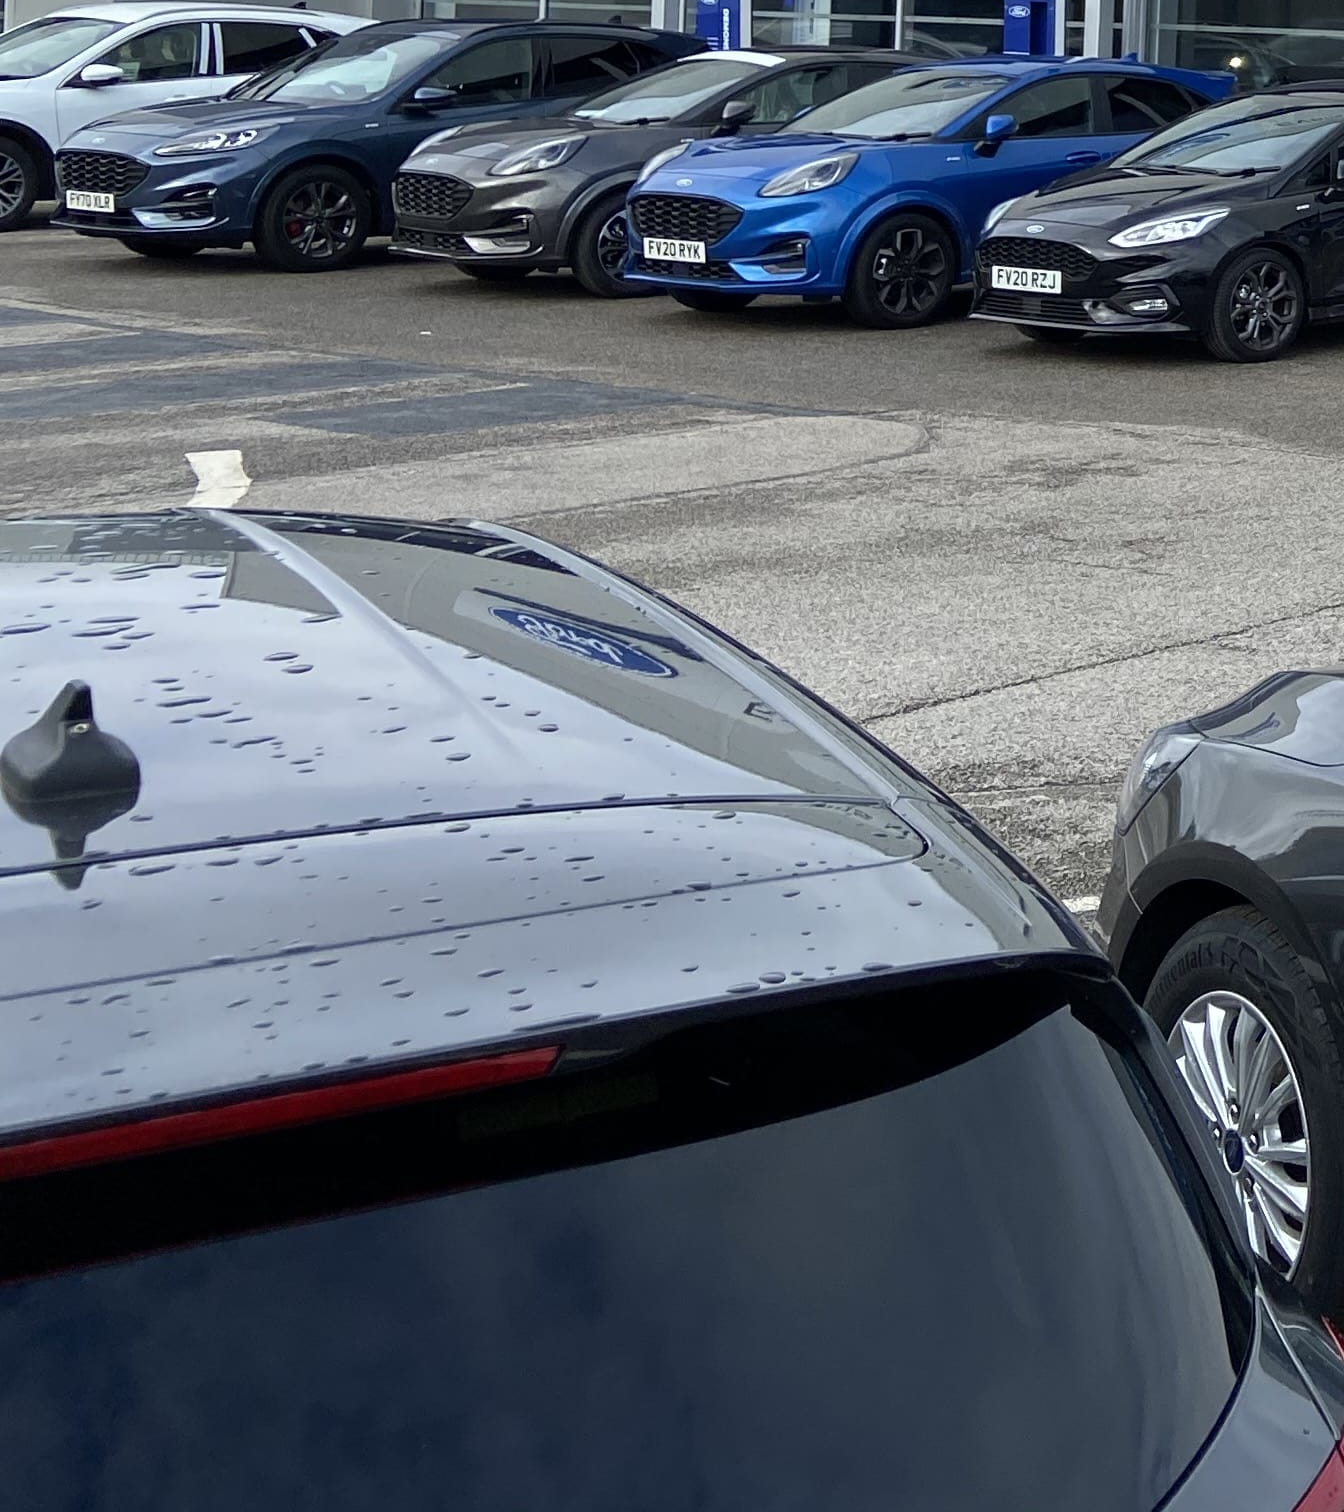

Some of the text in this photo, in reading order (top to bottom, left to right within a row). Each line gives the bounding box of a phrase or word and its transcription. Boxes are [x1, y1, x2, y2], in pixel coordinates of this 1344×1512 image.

[648, 239, 701, 259] FV20 RYK
[997, 268, 1056, 289] FV20 RZJ
